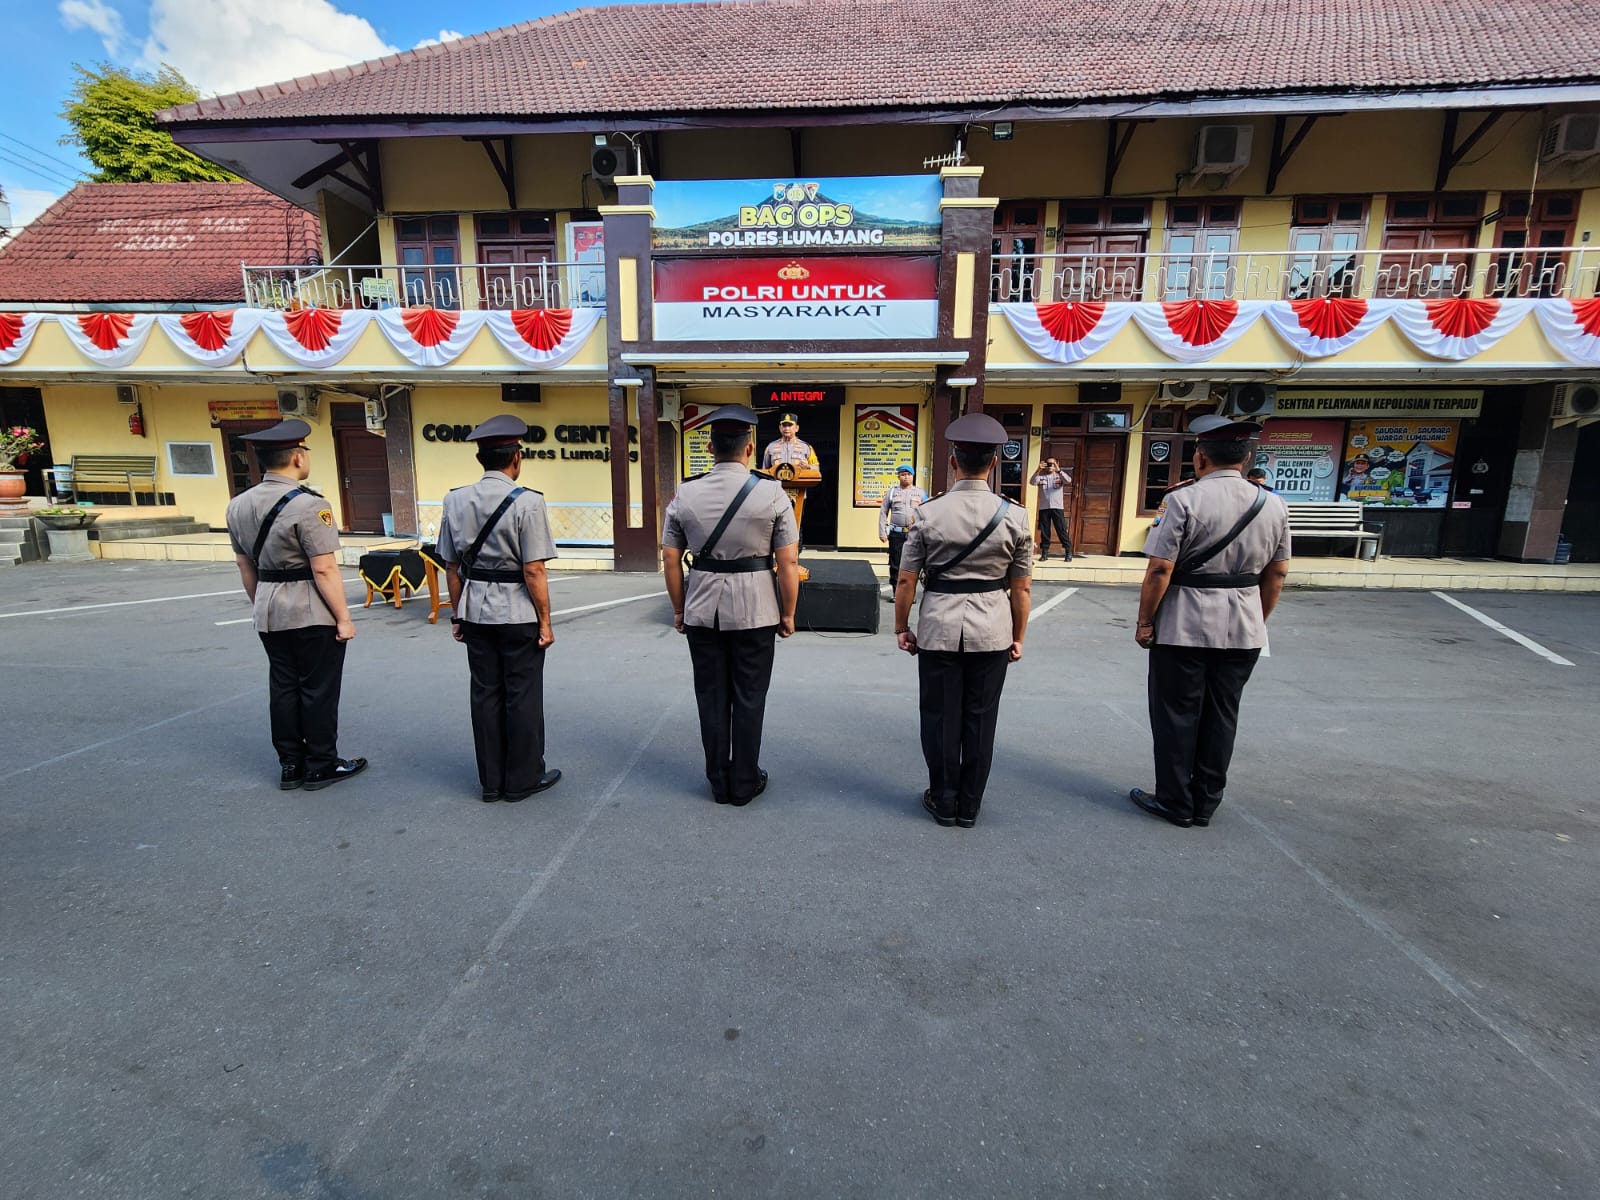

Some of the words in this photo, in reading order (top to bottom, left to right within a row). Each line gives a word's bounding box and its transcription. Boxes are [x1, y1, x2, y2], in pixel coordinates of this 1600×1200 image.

[739, 204, 794, 228] BAG
[797, 203, 853, 227] OPS
[708, 231, 778, 247] POLRES
[783, 230, 884, 246] LUMAJANG
[703, 285, 783, 300] POLRI
[792, 284, 887, 299] UNTUK
[703, 304, 888, 318] MASYARAKAT
[1277, 398, 1315, 410] SENTRA
[1317, 398, 1370, 410] PELAYANAN
[1373, 398, 1431, 410] KEPOLISIAN
[1433, 398, 1478, 410] TERPADU
[422, 423, 547, 442] COMND
[554, 424, 638, 443] CENTR
[561, 447, 639, 463] Lumajg
[1276, 468, 1312, 478] POLRI
